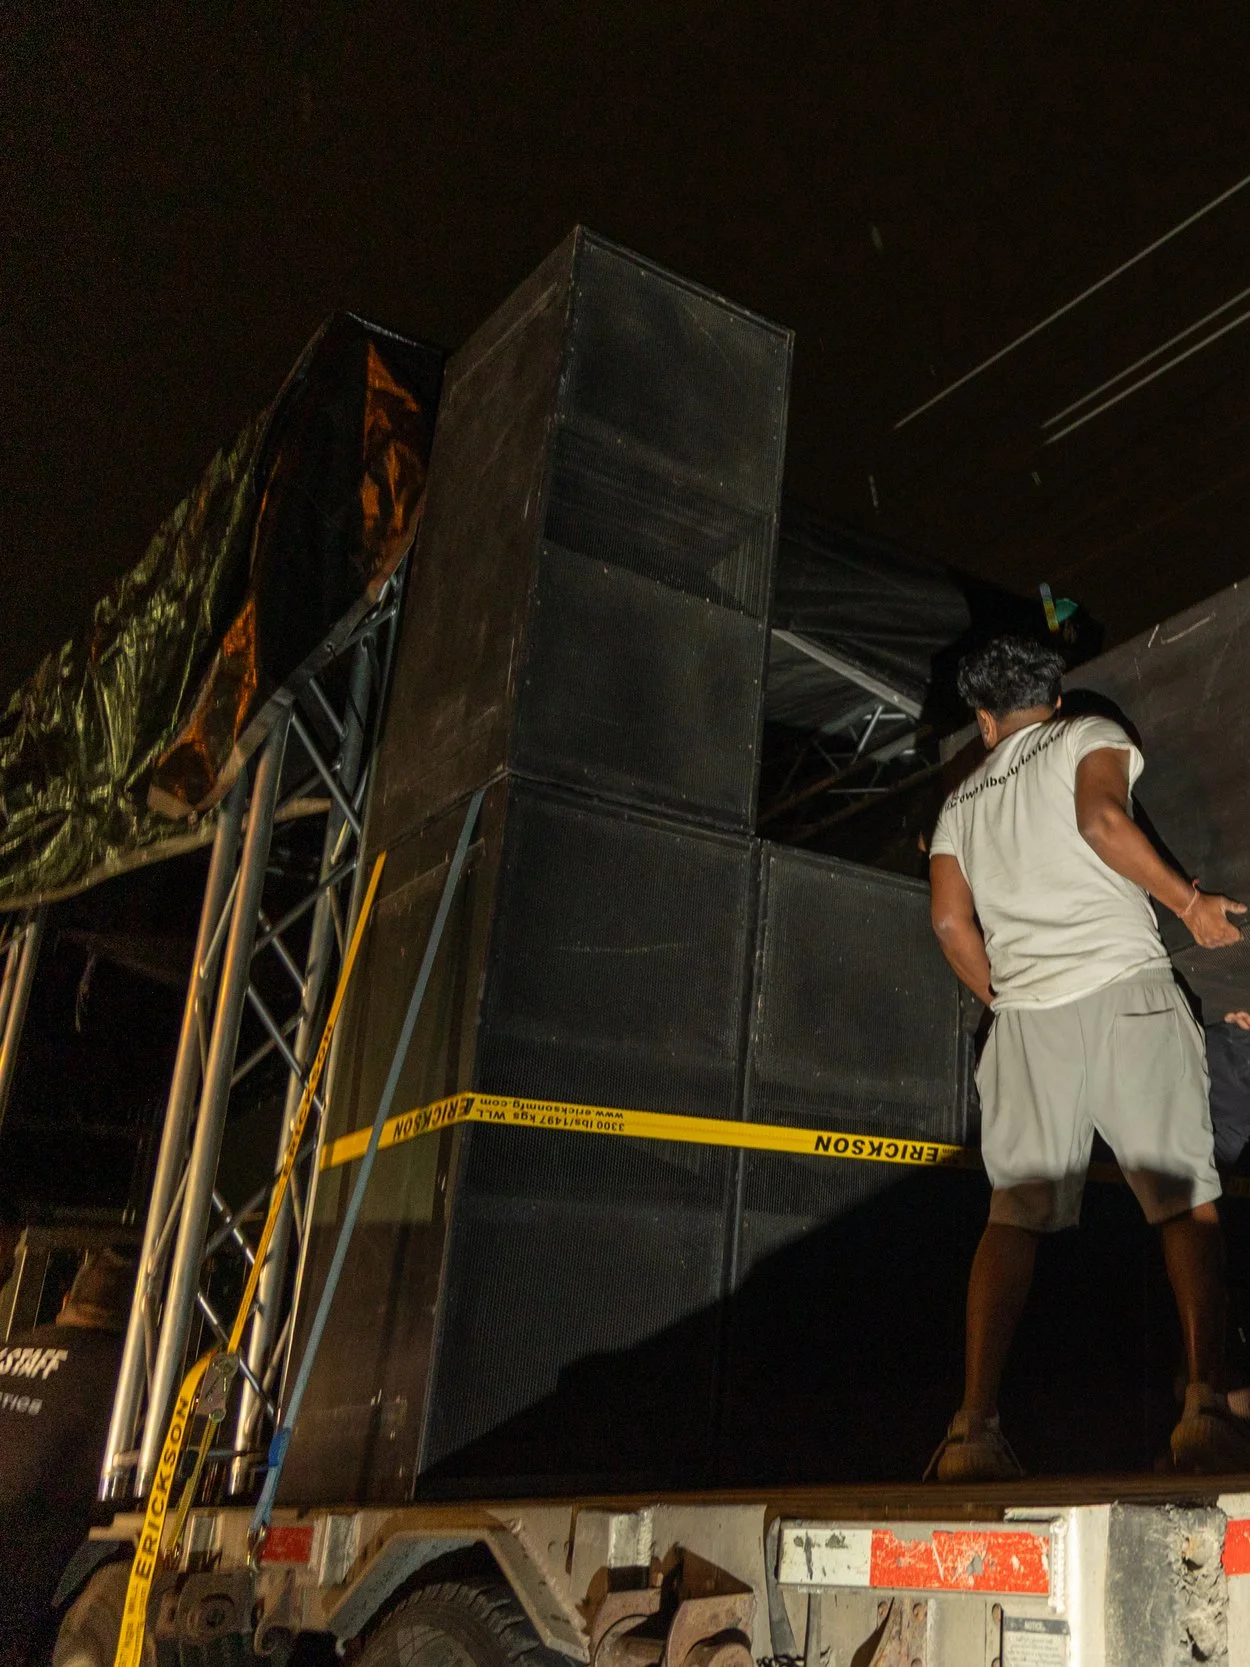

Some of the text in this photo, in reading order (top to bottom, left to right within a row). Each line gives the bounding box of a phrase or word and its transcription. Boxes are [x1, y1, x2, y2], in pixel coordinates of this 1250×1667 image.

[393, 1098, 476, 1142] ERICKSON
[475, 1108, 625, 1132] 3300 lbs/1497 kgs WLL
[479, 1098, 624, 1121] www.ericksonmfg.com
[814, 1136, 939, 1162] ERICKSON
[134, 1397, 190, 1580] ERICKSON
